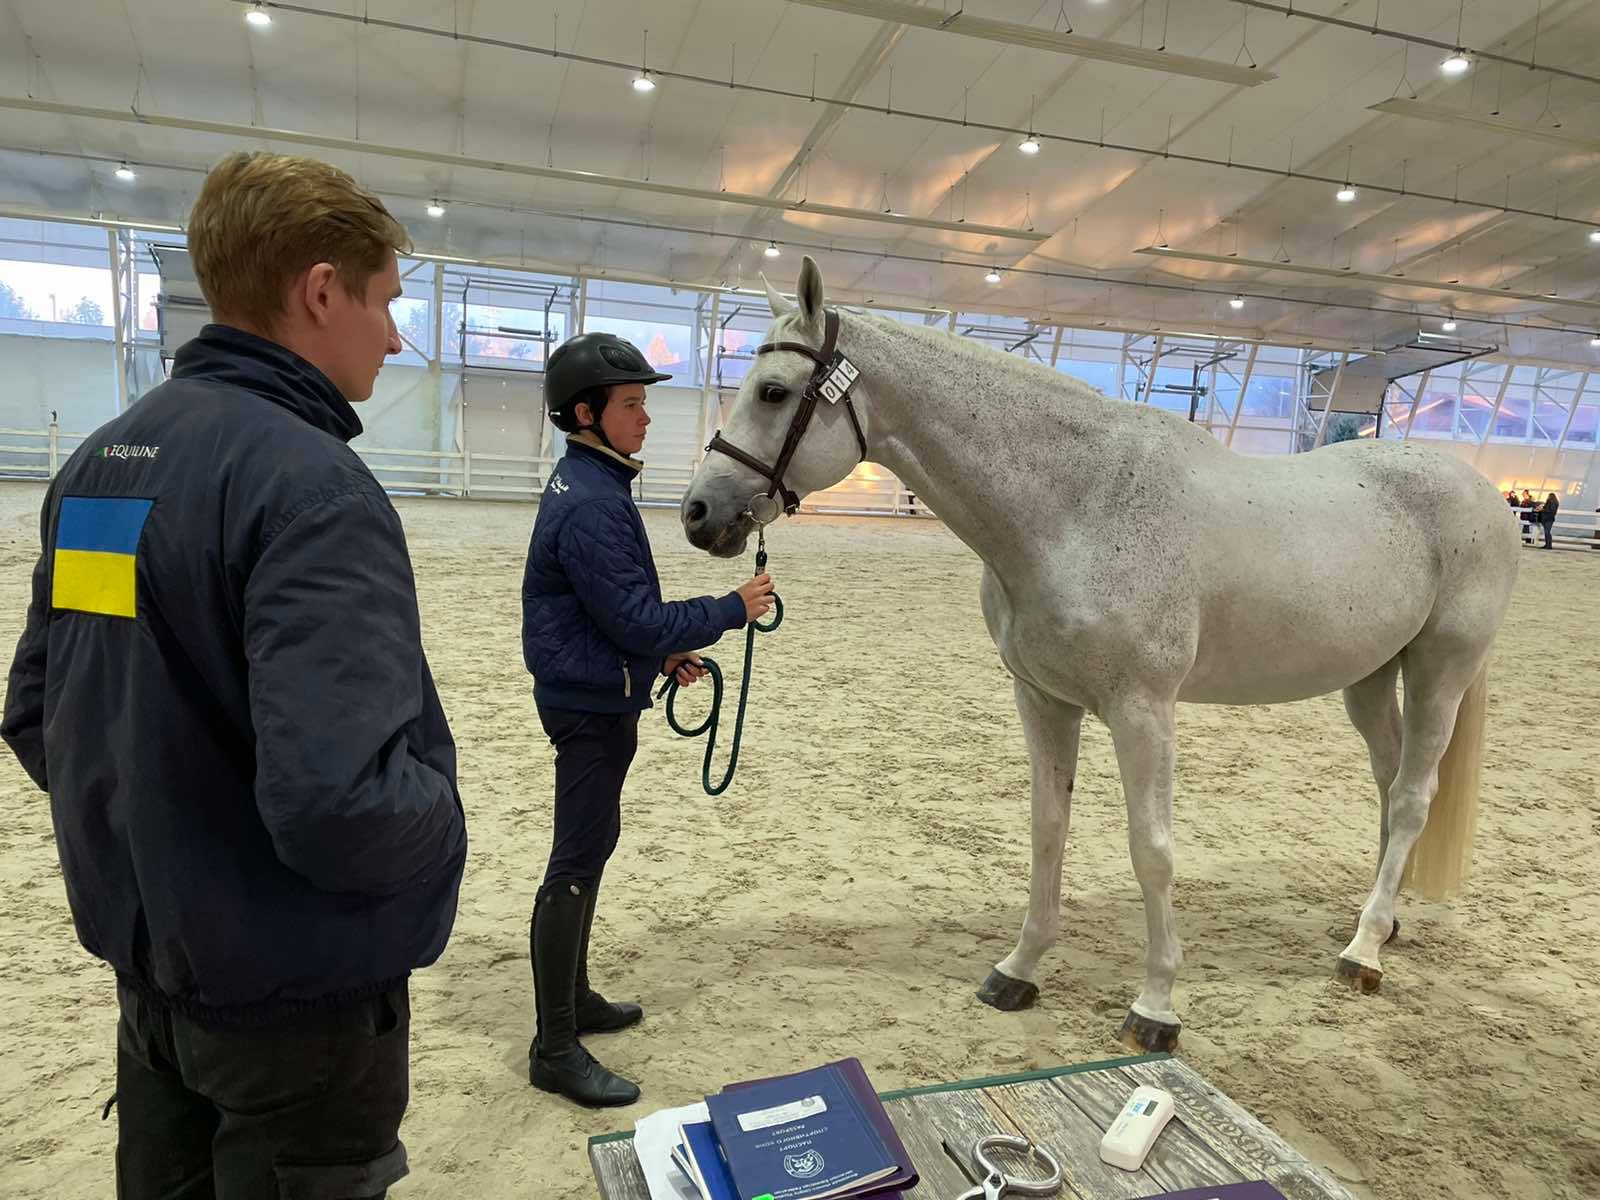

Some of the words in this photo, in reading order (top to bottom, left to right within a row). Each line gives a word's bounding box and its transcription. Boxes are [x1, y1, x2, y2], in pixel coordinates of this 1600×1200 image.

[825, 363, 855, 399] 014
[110, 444, 160, 460] EQUILINE
[772, 1124, 805, 1136] PASSPORT
